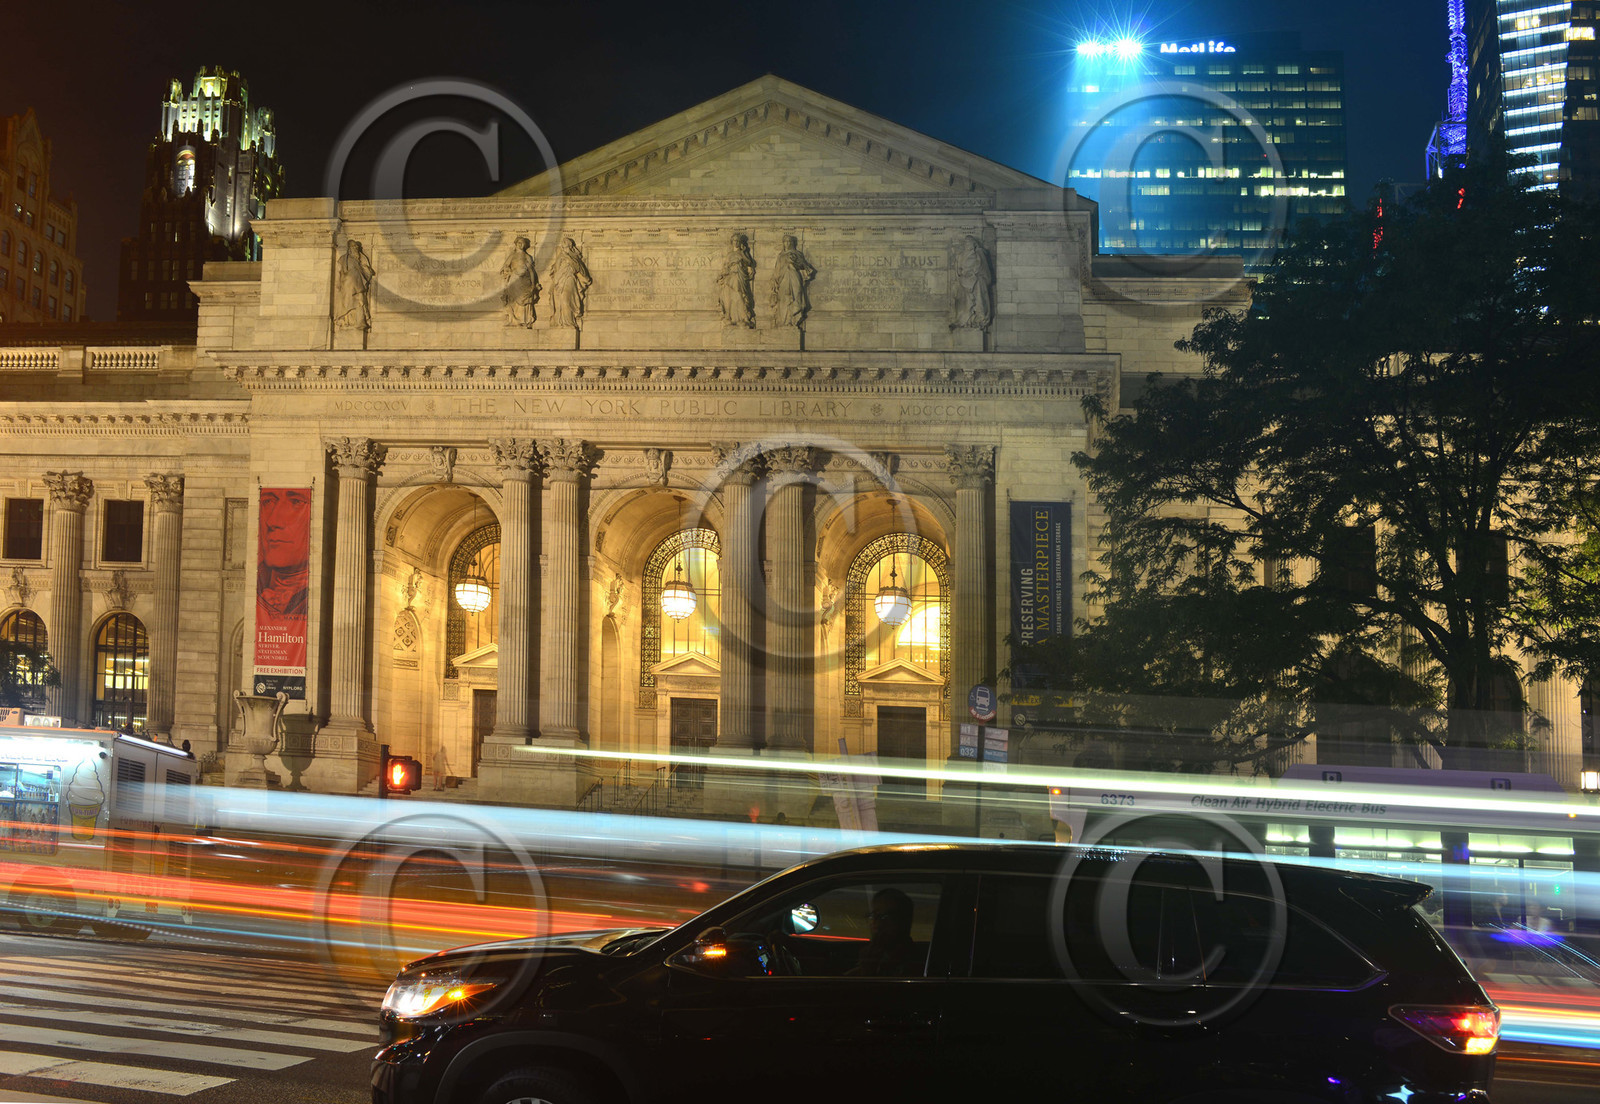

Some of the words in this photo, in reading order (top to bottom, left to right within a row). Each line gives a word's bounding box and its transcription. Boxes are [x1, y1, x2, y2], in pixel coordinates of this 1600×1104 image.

[1160, 41, 1236, 53] MetLife
[413, 259, 448, 270] ASOR
[451, 257, 497, 269] LIBARY
[849, 255, 893, 267] TILDEN
[903, 255, 941, 267] TRUST
[335, 401, 410, 412] MDCCCXCV
[456, 399, 498, 414] THE
[513, 399, 566, 414] NEW
[584, 400, 642, 415] YORK
[660, 400, 737, 416] PUBLIC
[760, 401, 853, 416] LIBRARY
[1035, 511, 1050, 631] MASTERPIECE
[1020, 568, 1034, 646] PRESERVING
[258, 632, 304, 644] Hamilton
[271, 667, 303, 675] EXHIBITION
[1100, 794, 1135, 807] 6373
[1190, 795, 1228, 808] Clean
[1231, 796, 1252, 808] Air
[1255, 797, 1301, 813] Hybrid
[1305, 799, 1357, 814] Electric
[1361, 802, 1386, 815] Bus
